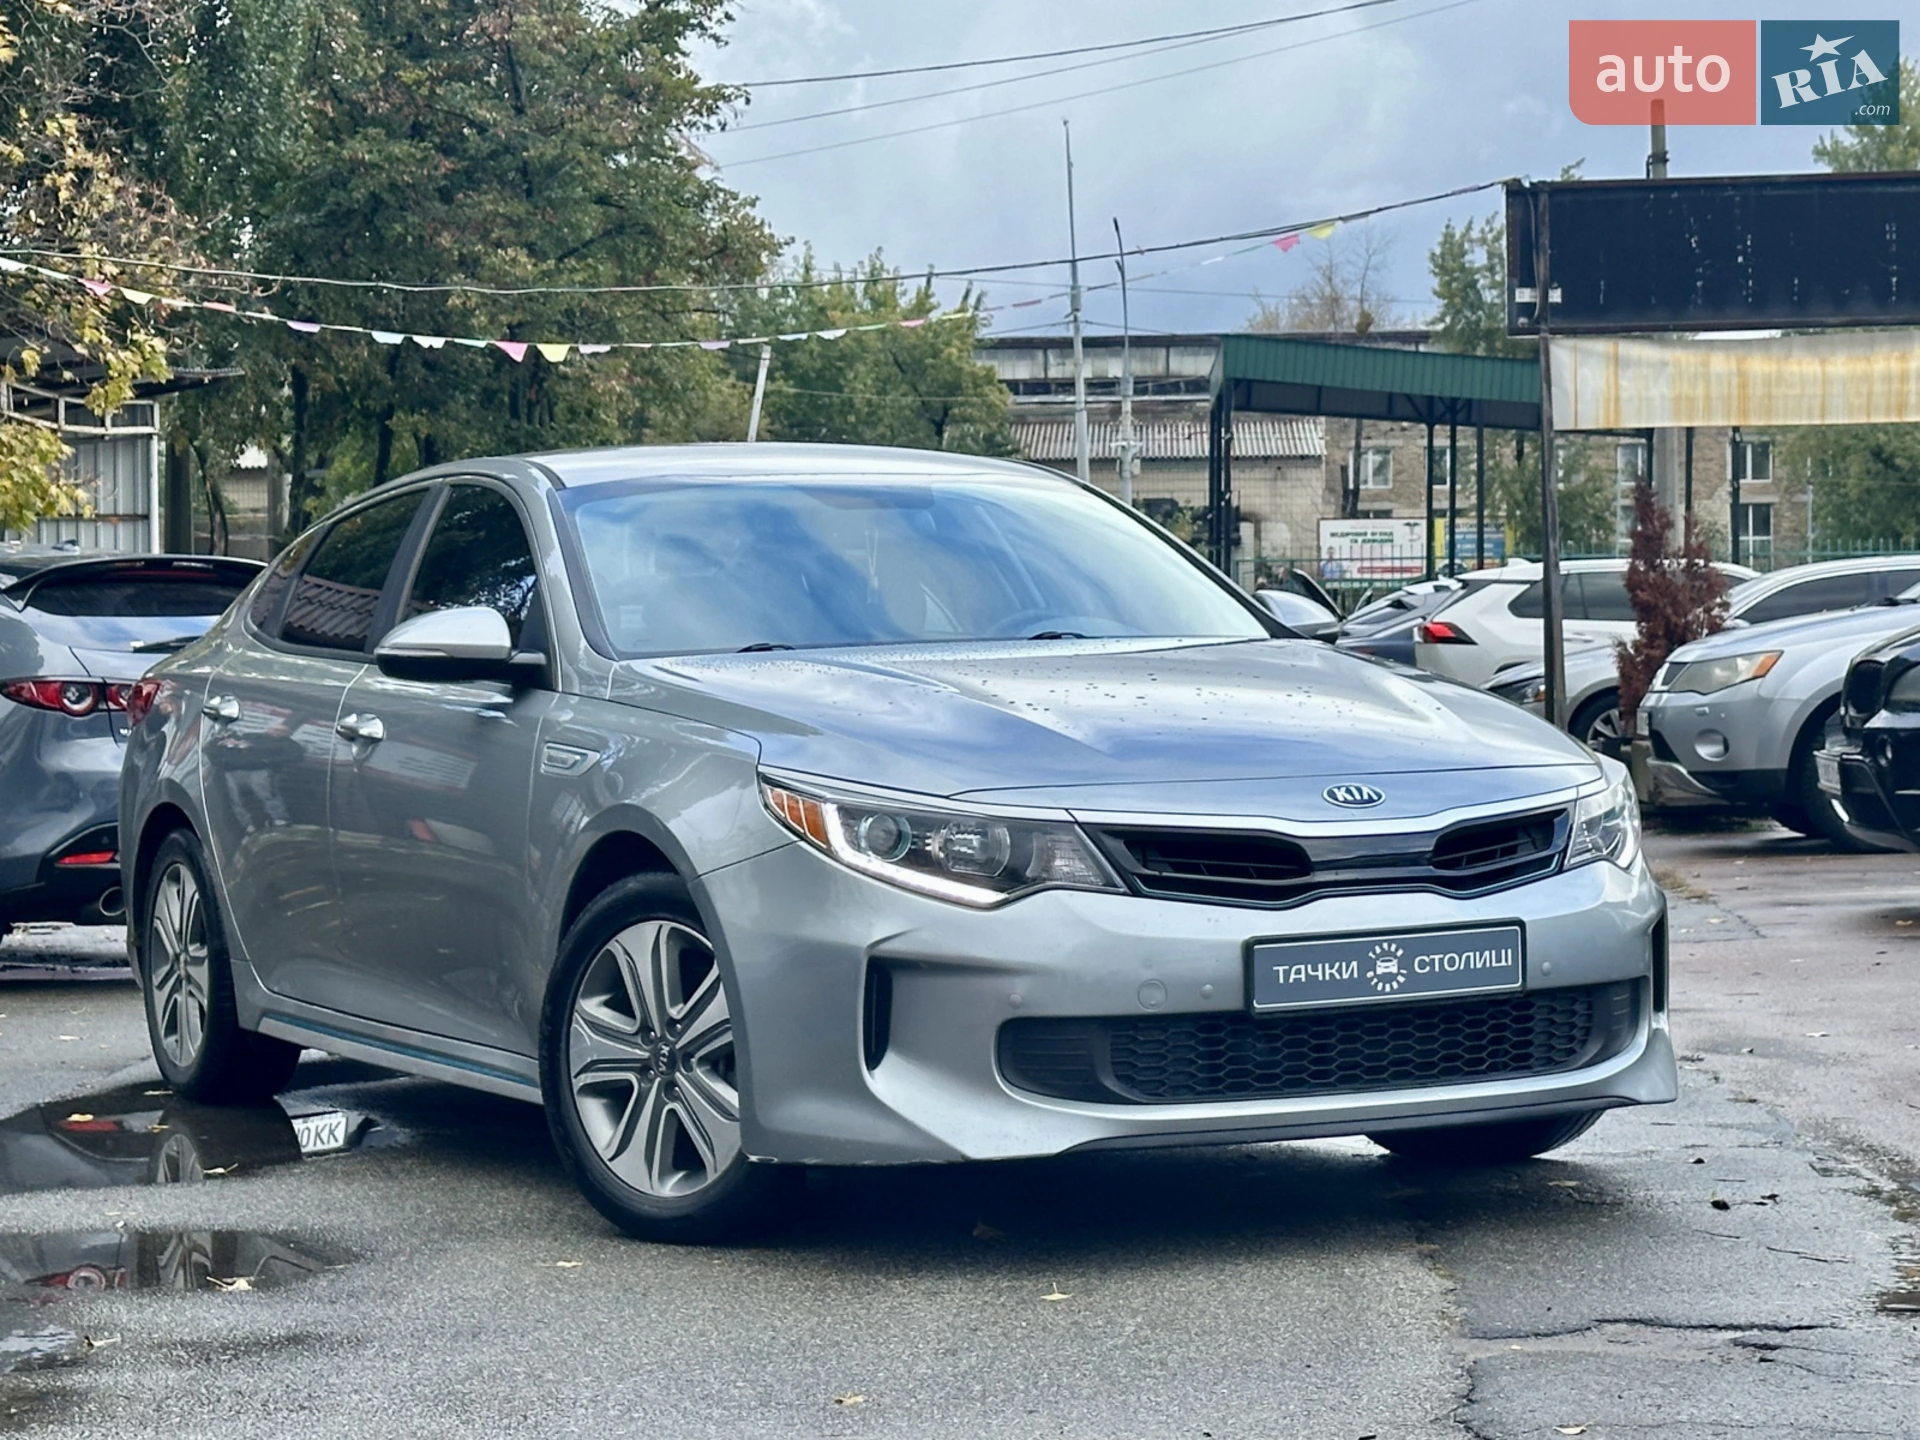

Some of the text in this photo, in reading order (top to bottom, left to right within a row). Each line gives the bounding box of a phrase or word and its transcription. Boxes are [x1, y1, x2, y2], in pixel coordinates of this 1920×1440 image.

[1331, 785, 1379, 802] KIA
[1272, 960, 1358, 984] ТАЧКИ
[659, 1044, 670, 1071] KIA
